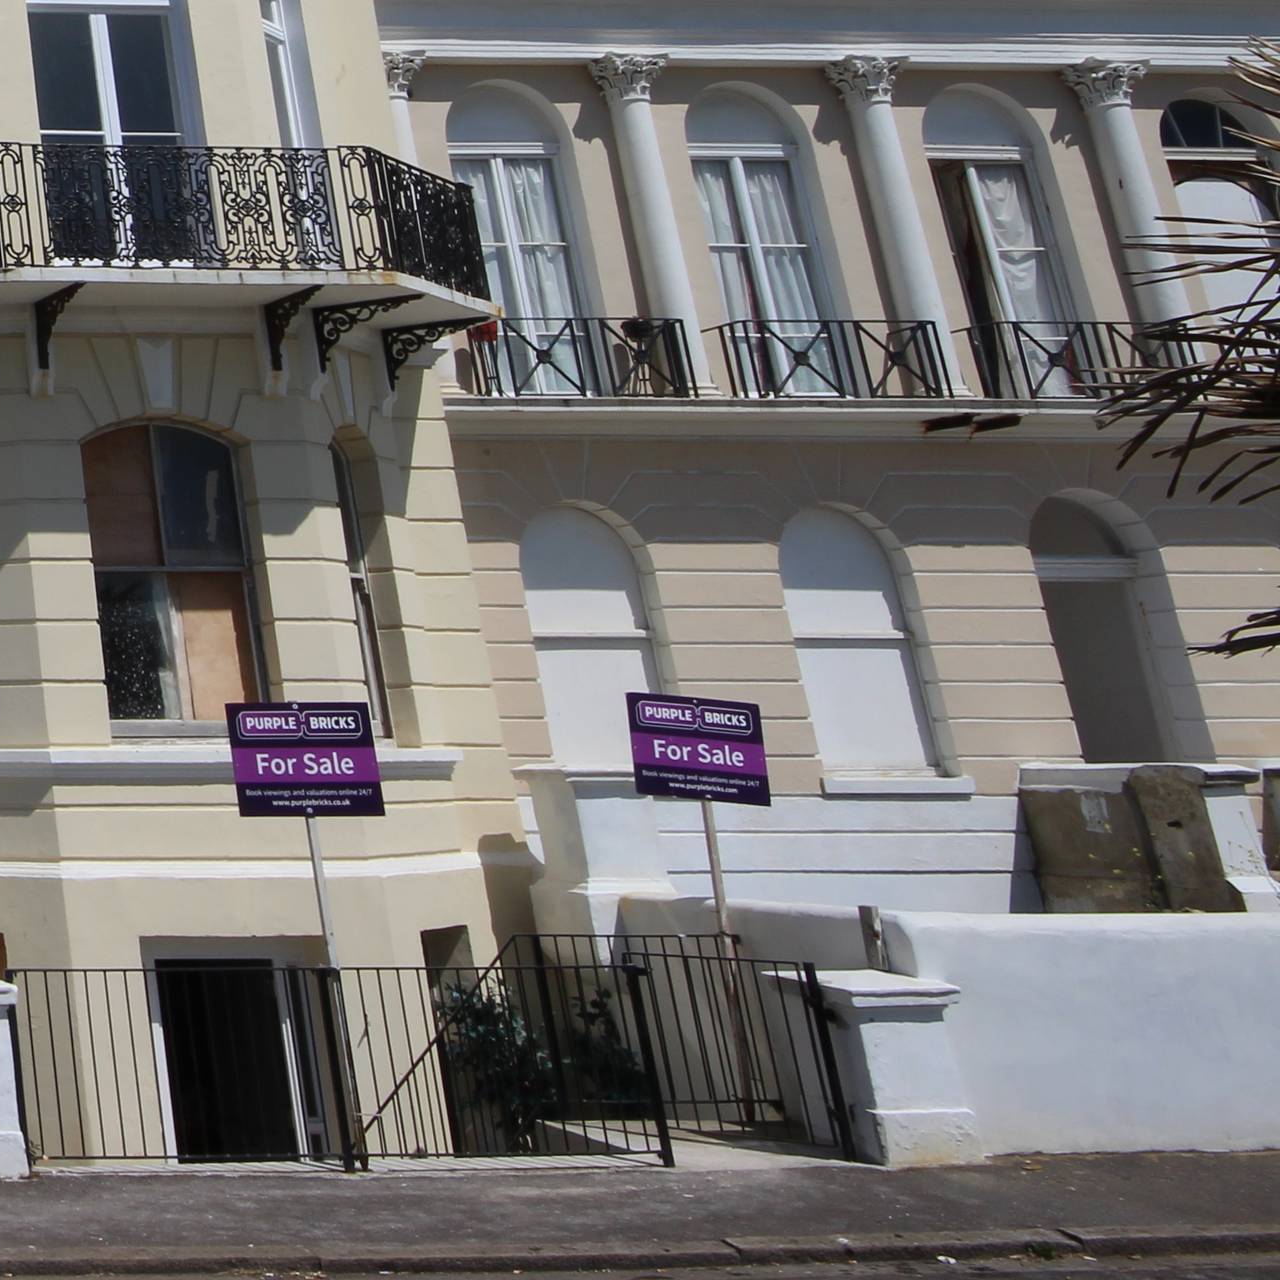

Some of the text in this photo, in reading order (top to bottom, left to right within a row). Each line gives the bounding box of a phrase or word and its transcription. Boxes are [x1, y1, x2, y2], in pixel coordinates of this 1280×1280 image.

[245, 716, 356, 730] PURPLE BRICKS
[644, 706, 747, 727] PURPLE BRICKS
[653, 739, 745, 767] For Sale
[255, 751, 355, 775] For Sale
[245, 788, 373, 798] Book viewings and valuations online 24/7
[669, 782, 738, 794] www.purplebricks.com
[272, 798, 351, 807] www.purplebricks.co.uk
